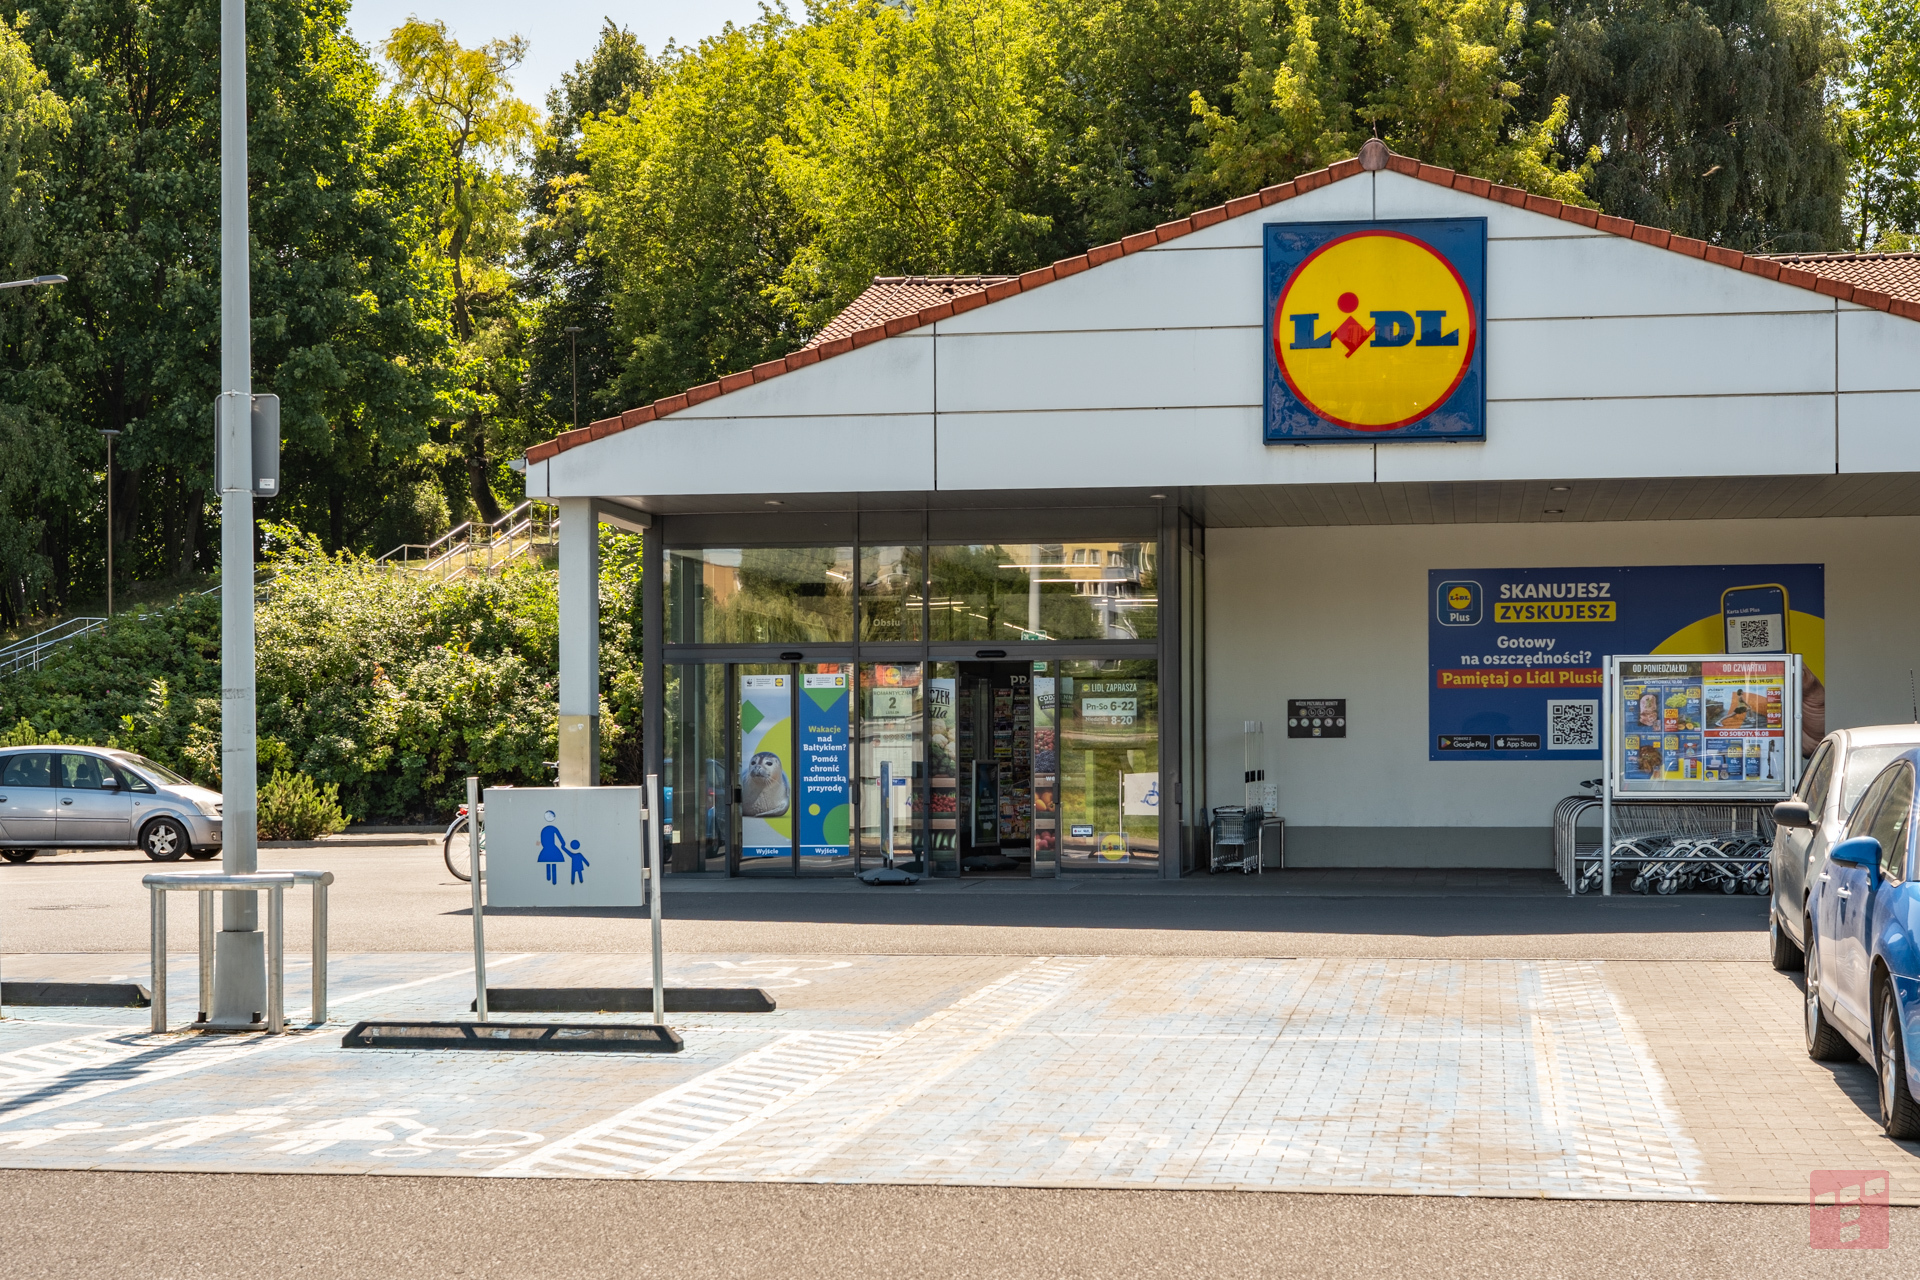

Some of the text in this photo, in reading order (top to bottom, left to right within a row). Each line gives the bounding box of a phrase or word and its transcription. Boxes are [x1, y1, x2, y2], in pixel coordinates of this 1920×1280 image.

[1289, 292, 1459, 359] LIDL
[1500, 582, 1611, 599] SKANUJESZ
[1500, 604, 1611, 620] ZYSKUJESZ
[1450, 612, 1470, 622] Plus
[1497, 635, 1556, 651] Gotowy
[1461, 651, 1592, 667] na oszczędności?
[1633, 664, 1687, 672] OD PONIEDZIAŁKU
[1722, 664, 1766, 672] OD CZWARTKU
[1442, 671, 1509, 688] Pamiętaj
[1513, 674, 1522, 684] o
[1526, 671, 1555, 684] Lidl
[1092, 684, 1137, 692] LIDL ZAPRASZA
[889, 697, 897, 709] 2
[1110, 701, 1134, 711] 6-22
[1111, 716, 1133, 725] 8-20
[808, 725, 841, 734] Wakacje
[803, 743, 846, 752] Bałtykiem?
[1453, 741, 1488, 749] Google Play
[812, 755, 838, 763] Pomóż
[810, 765, 839, 773] chronić
[803, 775, 846, 784] nadmorską
[807, 784, 842, 793] przyrodę
[815, 847, 838, 855] Wyjście
